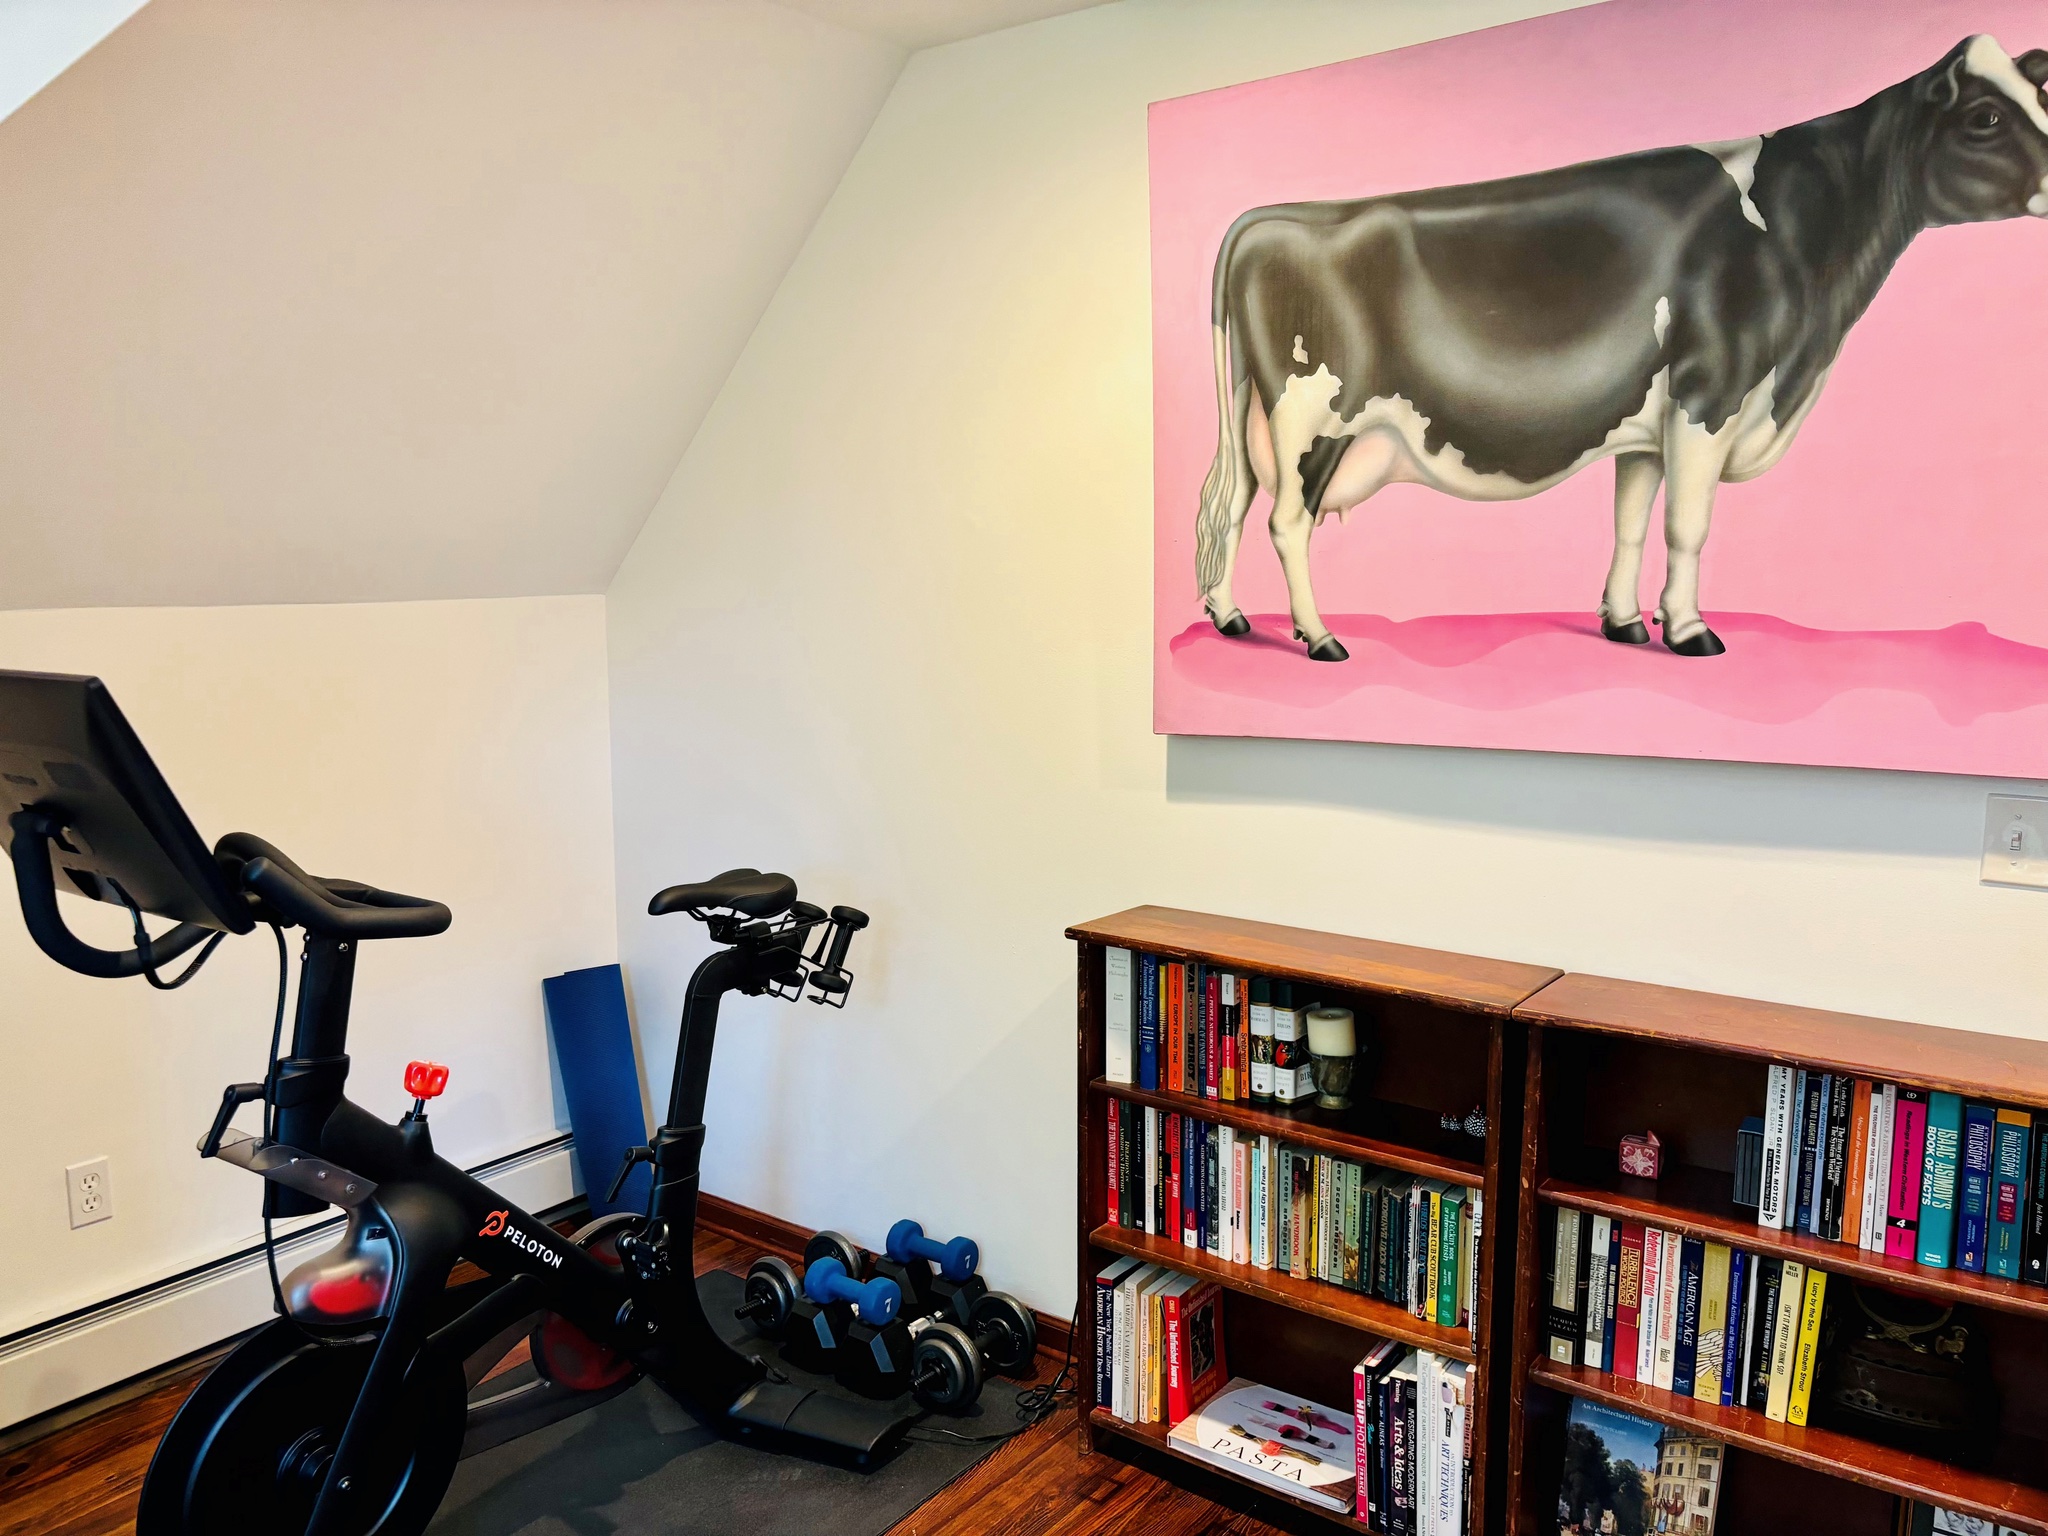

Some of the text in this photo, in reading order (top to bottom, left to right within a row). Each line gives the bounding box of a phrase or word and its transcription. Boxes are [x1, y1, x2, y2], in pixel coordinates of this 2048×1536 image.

[1781, 1068, 1787, 1082] MY
[1811, 1091, 1820, 1111] RETURN
[1808, 1120, 1818, 1146] LAUGHTER
[1838, 1126, 1846, 1137] The
[1904, 1110, 1913, 1140] Readings
[1774, 1137, 1782, 1176] GENERAL
[1829, 1136, 1838, 1158] System
[1836, 1138, 1844, 1152] Irony
[1966, 1122, 1985, 1171] PHILOSOPHY
[2000, 1130, 2018, 1178] PHILOSOPHY
[1833, 1161, 1842, 1186] Vietnam:
[1922, 1125, 1937, 1206] BOOK OF FACTS
[1931, 1128, 1958, 1210] ISAAC ASIMOV'S
[1108, 1168, 1116, 1190] MAJORITY
[1899, 1175, 1908, 1210] Civilization
[1420, 1200, 1428, 1228] WEBELOS
[1896, 1219, 1906, 1228] 4
[1431, 1218, 1439, 1238] BEAR
[1668, 1233, 1678, 1243] The
[503, 1225, 563, 1269] PELOTON
[1420, 1231, 1428, 1254] SCOUT
[964, 1254, 971, 1269] 7
[1570, 1255, 1576, 1265] TO
[1643, 1230, 1661, 1296] Redeeming America
[1666, 1244, 1677, 1284] Democratization
[1627, 1250, 1640, 1306] TURBULENCE
[1731, 1272, 1740, 1304] Environmental
[1811, 1282, 1820, 1298] Lucy
[884, 1297, 892, 1314] 7
[1097, 1286, 1106, 1325] AMERICAN
[1664, 1289, 1674, 1312] American
[1685, 1272, 1698, 1324] AMERICAN
[1810, 1298, 1818, 1307] by
[1783, 1304, 1792, 1317] ISN'T
[1660, 1312, 1674, 1341] Christianity
[1683, 1326, 1695, 1346] AGE
[1780, 1324, 1790, 1342] PRETTY
[1808, 1319, 1816, 1331] Sea
[1097, 1326, 1106, 1358] HISTORY
[1170, 1320, 1179, 1388] The Unfinished Journey
[1660, 1348, 1670, 1362] Hatch
[1778, 1349, 1787, 1364] THINK
[1802, 1343, 1811, 1372] Elizabeth
[1777, 1366, 1786, 1375] SO?
[1799, 1373, 1808, 1392] Strout
[1394, 1416, 1404, 1443] Arts
[1592, 1406, 1631, 1422] Architectural
[1631, 1416, 1654, 1429] History
[1357, 1425, 1366, 1464] HOTELS
[1394, 1444, 1404, 1458] &
[1210, 1438, 1302, 1481] PASTA
[1394, 1458, 1404, 1490] Ideas
[1438, 1440, 1450, 1522] ART TECHNIQUES
